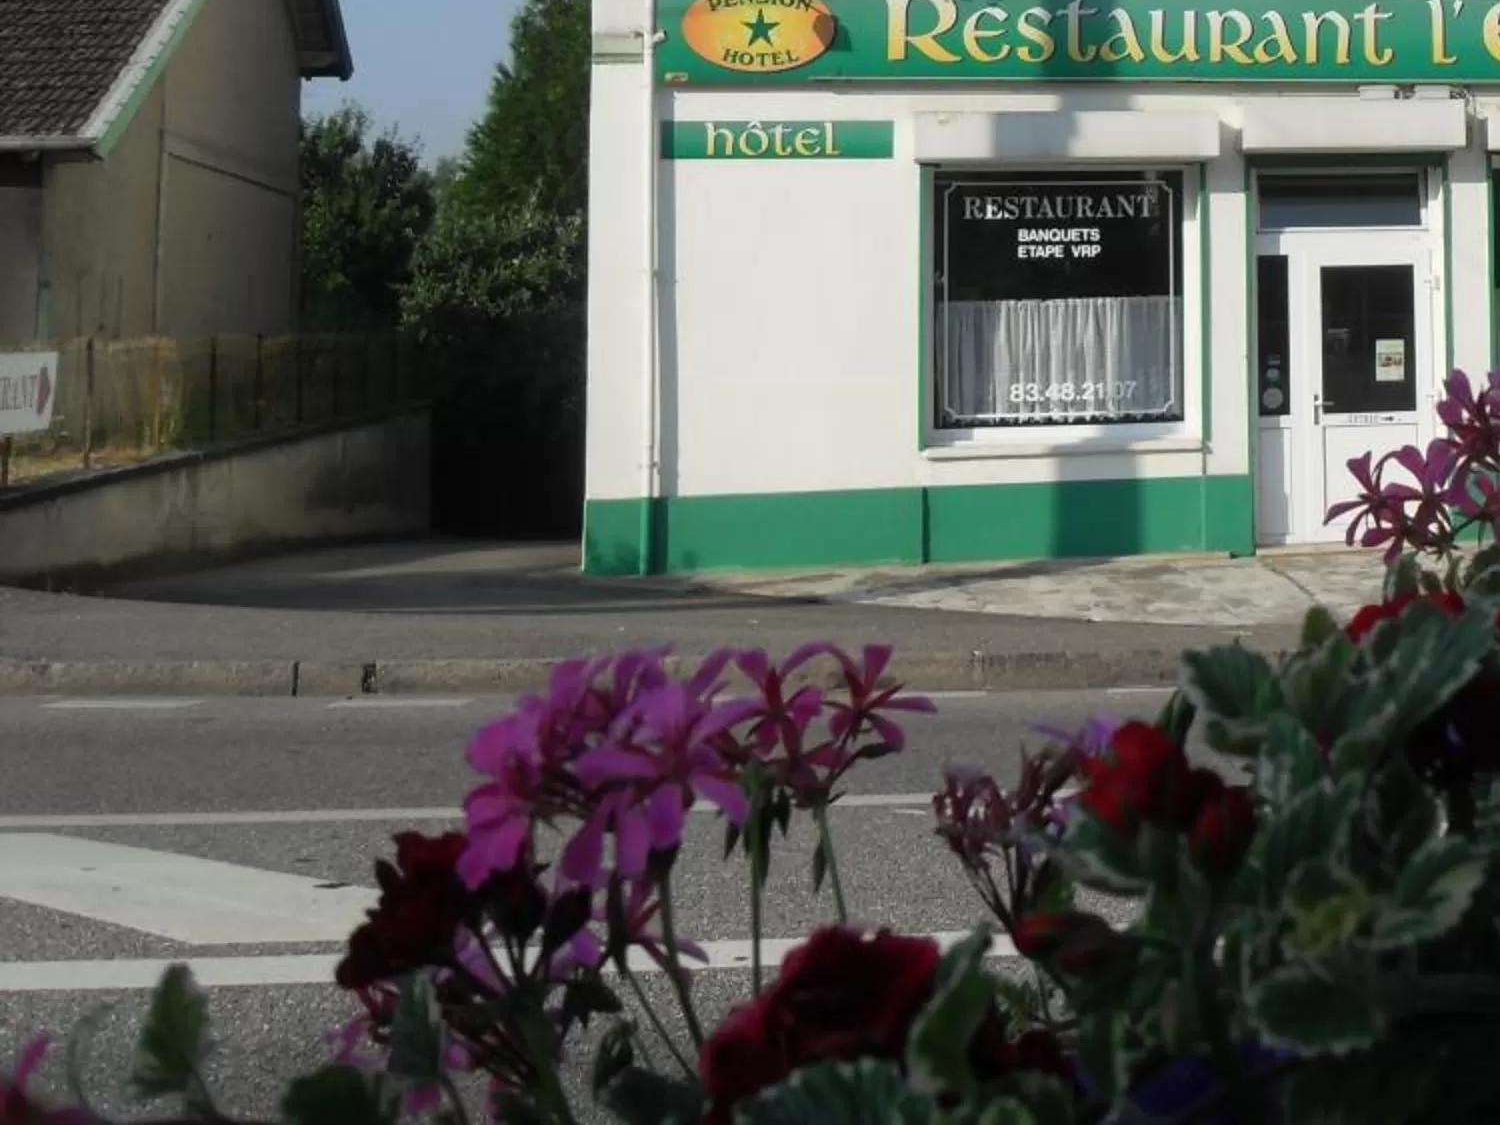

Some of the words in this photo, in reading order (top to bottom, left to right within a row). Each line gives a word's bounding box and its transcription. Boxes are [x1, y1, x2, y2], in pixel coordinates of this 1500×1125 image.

[721, 48, 800, 66] HOTEL
[706, 120, 841, 156] hôtel
[963, 195, 1153, 220] RESTAURANT
[1017, 228, 1101, 242] BANQUETS
[1017, 245, 1065, 258] ETAPE
[1071, 245, 1101, 258] VRP
[1009, 381, 1137, 402] 83.48.2107
